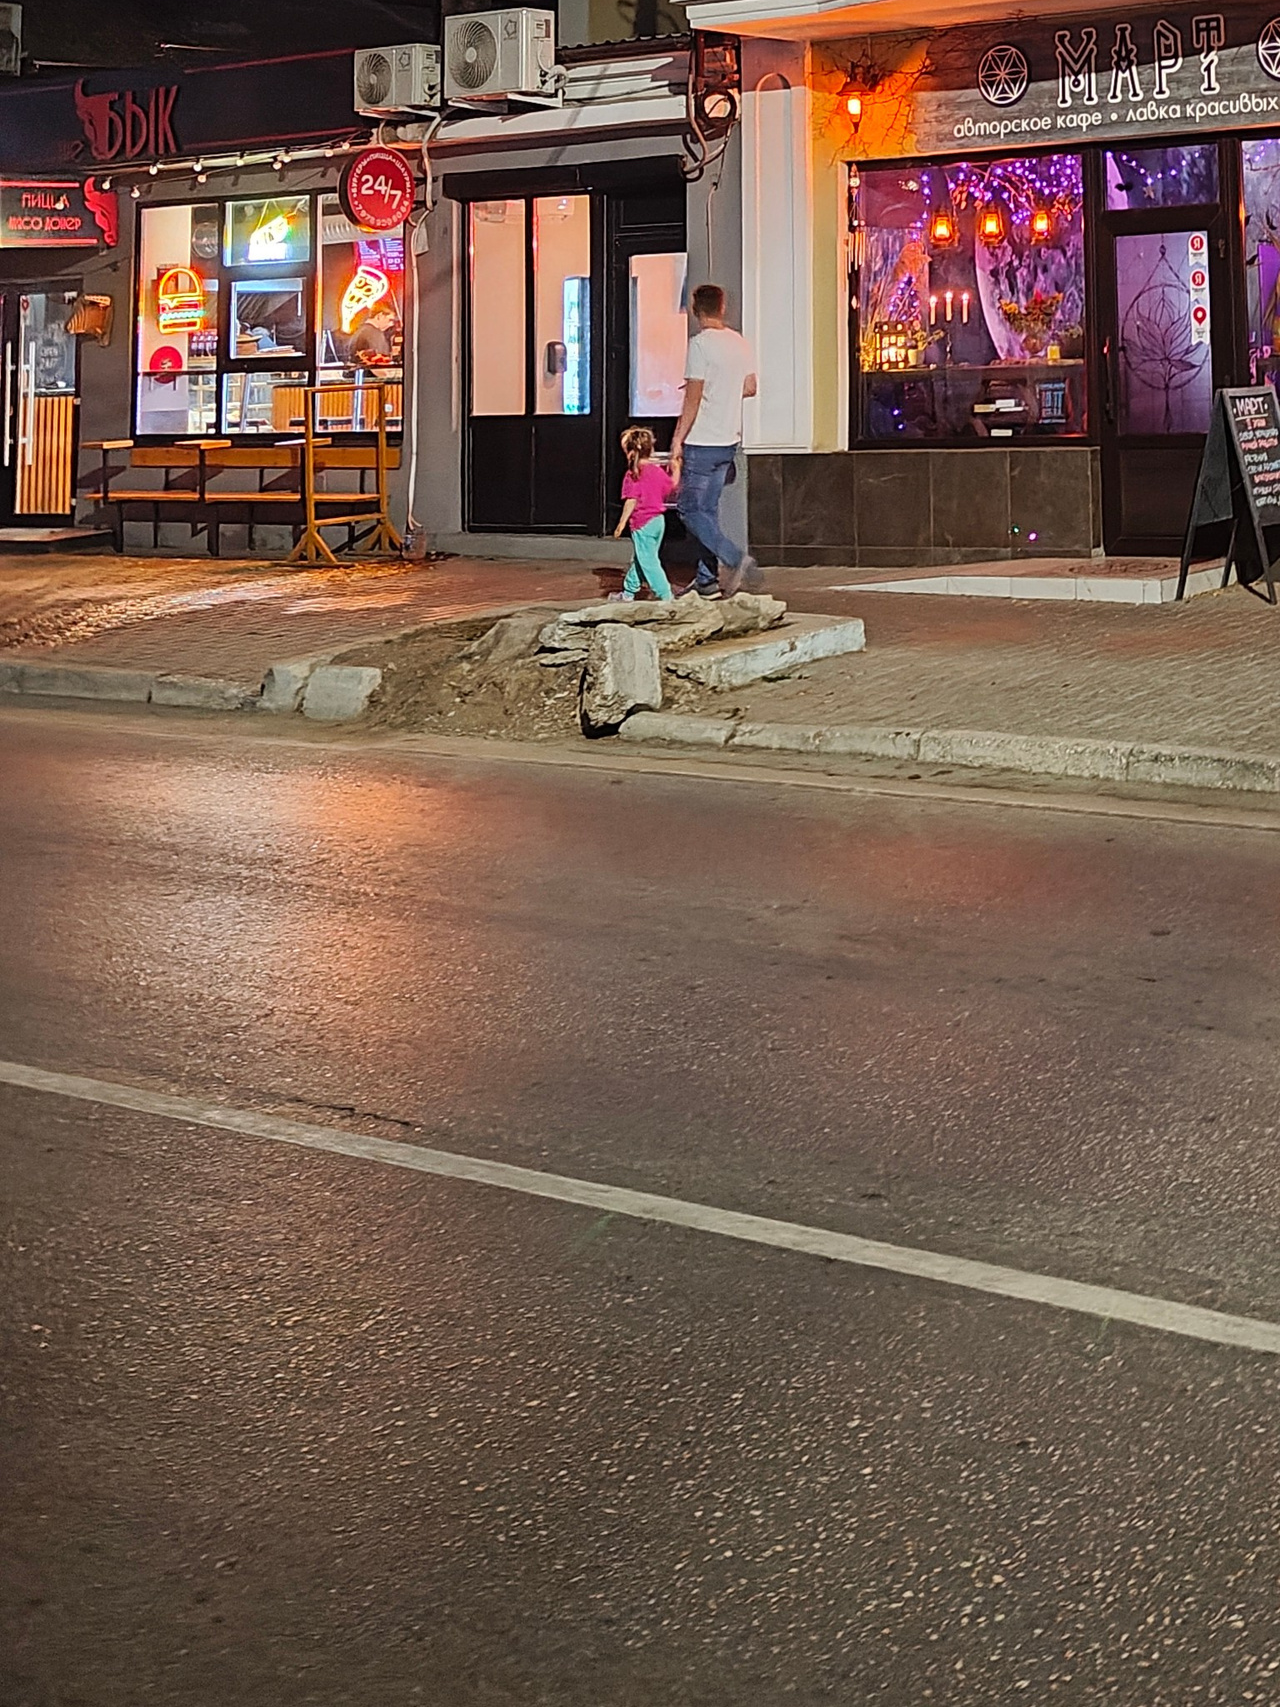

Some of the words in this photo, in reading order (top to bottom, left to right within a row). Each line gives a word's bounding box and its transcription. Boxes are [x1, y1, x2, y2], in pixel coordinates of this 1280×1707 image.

[1055, 13, 1226, 107] МАРТ
[76, 81, 178, 160] БЫК
[953, 116, 1052, 139] авторское
[1056, 111, 1102, 132] кафе
[1125, 100, 1181, 122] лавка
[1186, 92, 1279, 123] красивых
[21, 192, 70, 209] ПИЦЦА
[361, 174, 402, 210] 24/7
[1235, 397, 1265, 417] МАРТ
